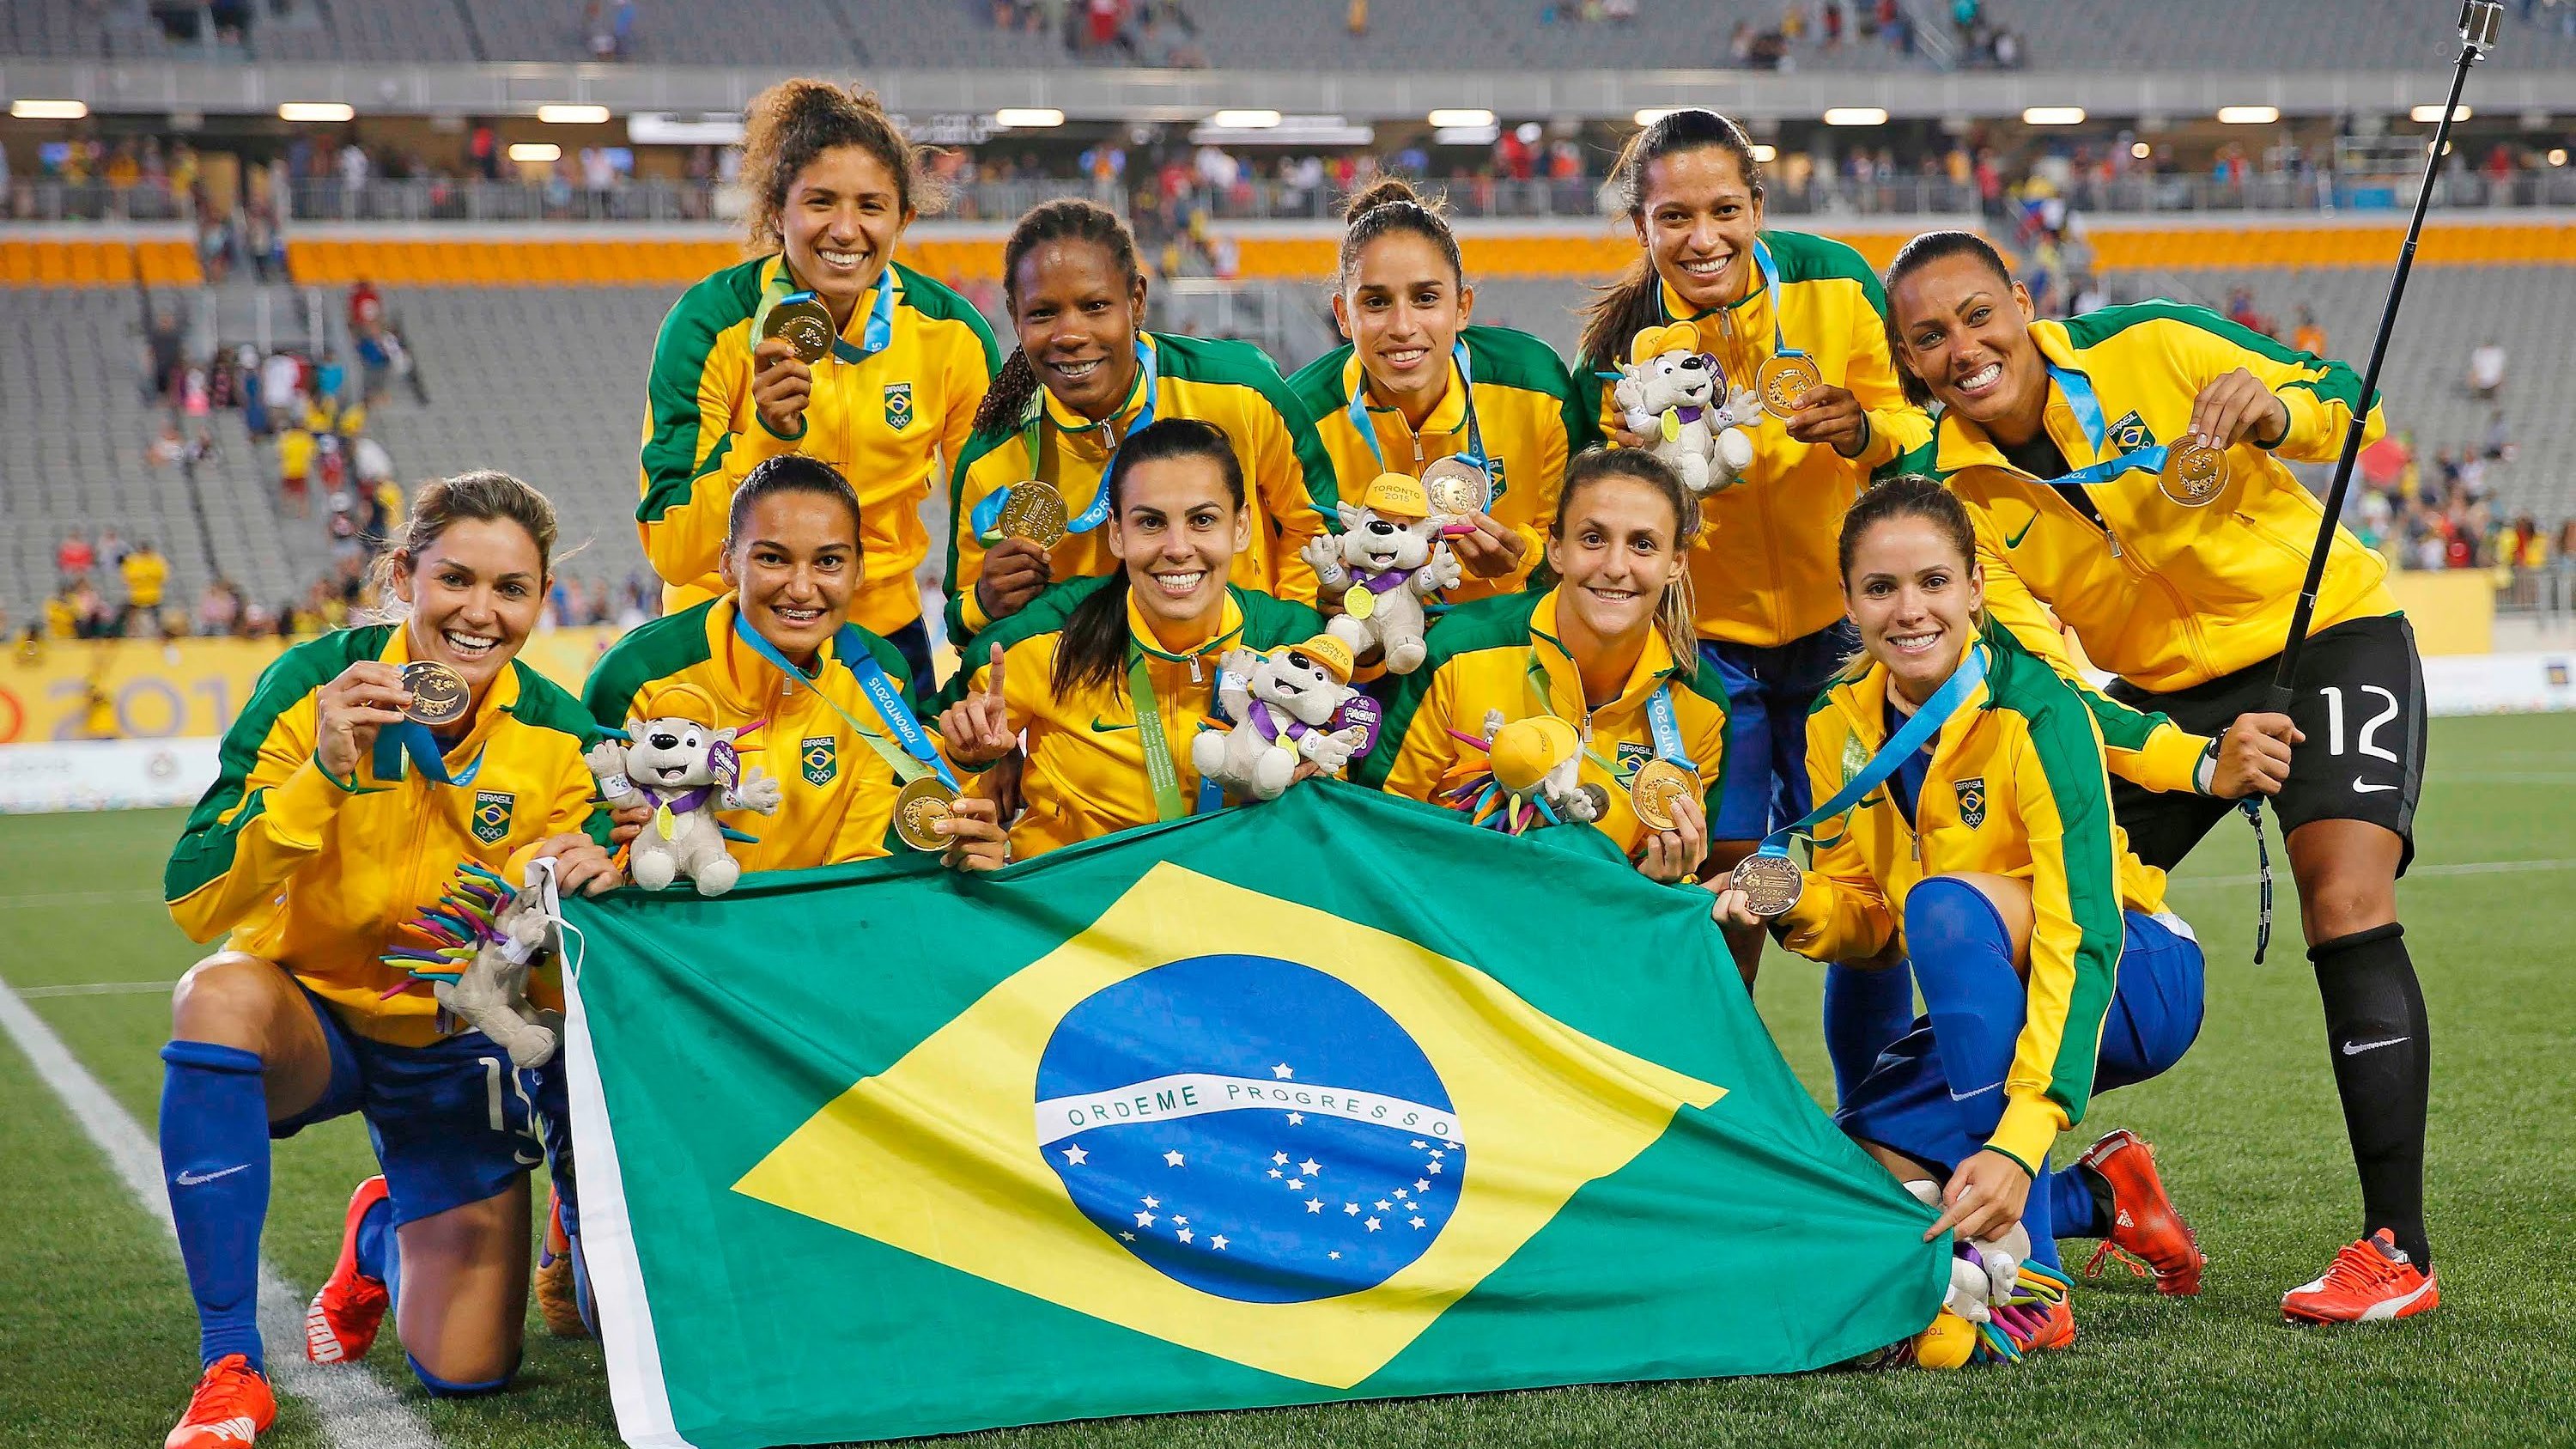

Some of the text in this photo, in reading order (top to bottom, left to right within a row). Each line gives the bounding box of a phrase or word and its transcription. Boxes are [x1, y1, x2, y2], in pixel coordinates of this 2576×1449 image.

[884, 384, 910, 393] BRASIL
[2107, 413, 2138, 436] BRASIL
[1374, 485, 1420, 500] TORONTO
[1384, 492, 1411, 502] 2015
[1084, 486, 1110, 523] TORO
[1309, 637, 1350, 667] TORONTO
[1315, 643, 1339, 661] 2015
[1345, 707, 1376, 723] PACHI
[2319, 685, 2399, 764] 12
[802, 737, 834, 747] BRASIL
[1619, 744, 1653, 756] BRASIL
[1955, 780, 1984, 791] BRASIL
[477, 793, 513, 804] BRASIL
[1226, 1083, 1449, 1136] PROGRESSO
